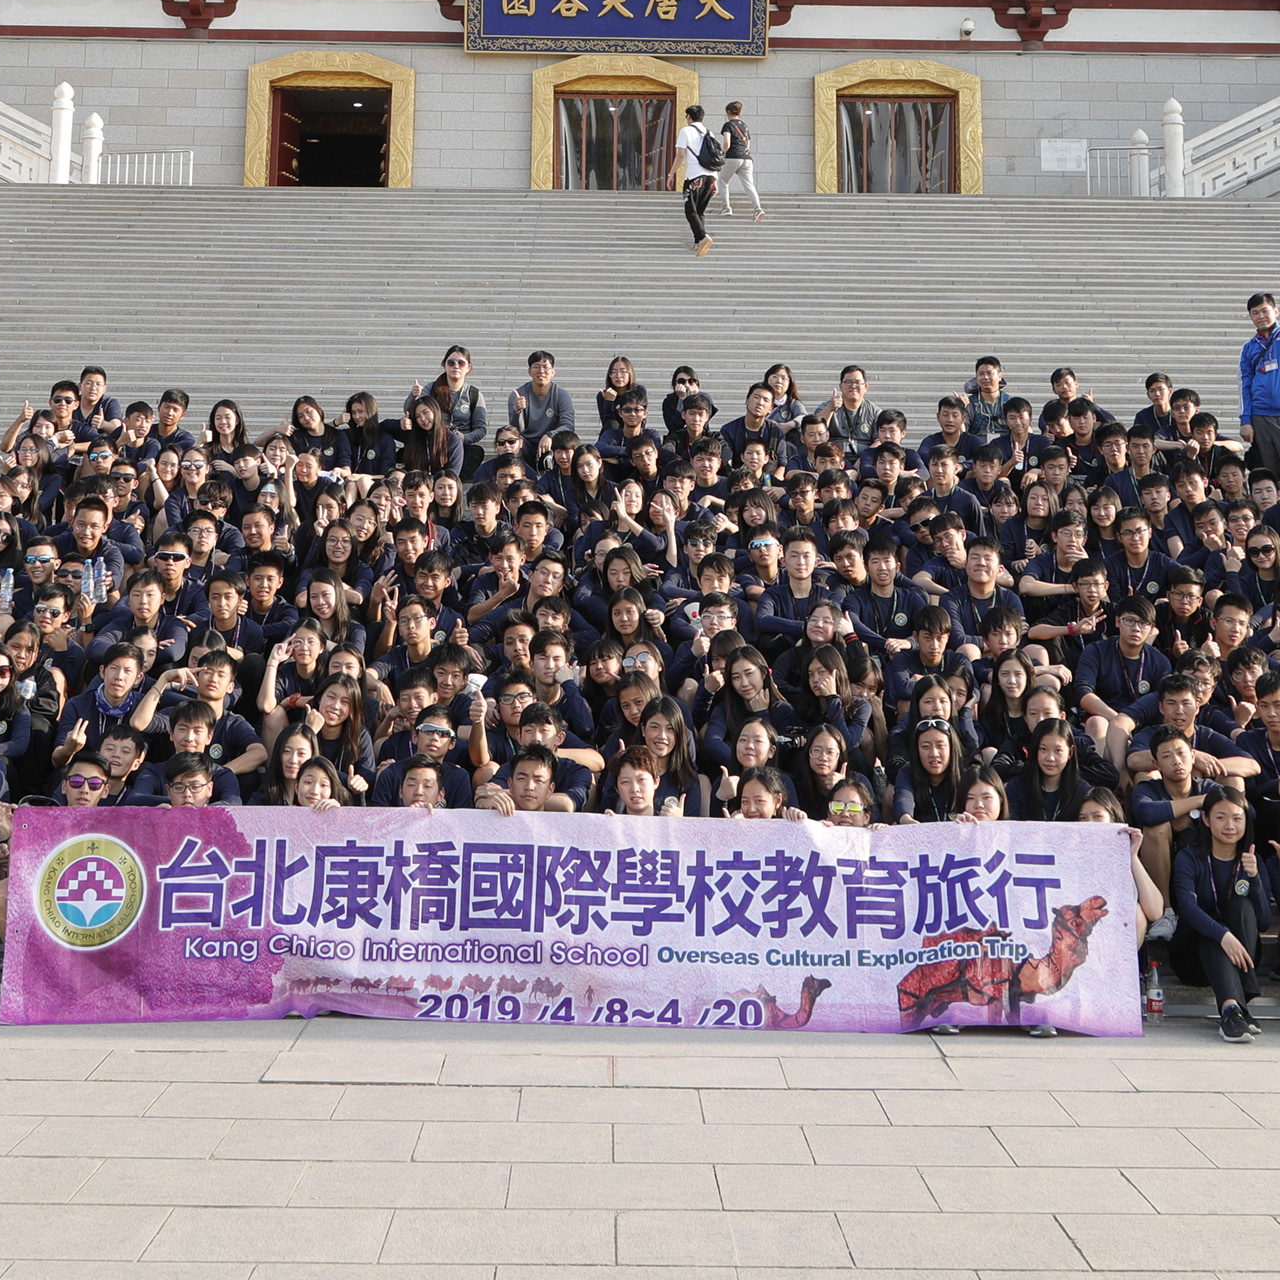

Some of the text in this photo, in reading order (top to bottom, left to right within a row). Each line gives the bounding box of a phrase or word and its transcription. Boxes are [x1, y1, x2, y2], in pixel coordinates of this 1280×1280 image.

[158, 837, 1062, 940] 台北康橋國際學校教育旅行
[185, 935, 1029, 970] Kang Chiao International School Overseas Cultural Exploration Trip
[418, 994, 522, 1020] 2019
